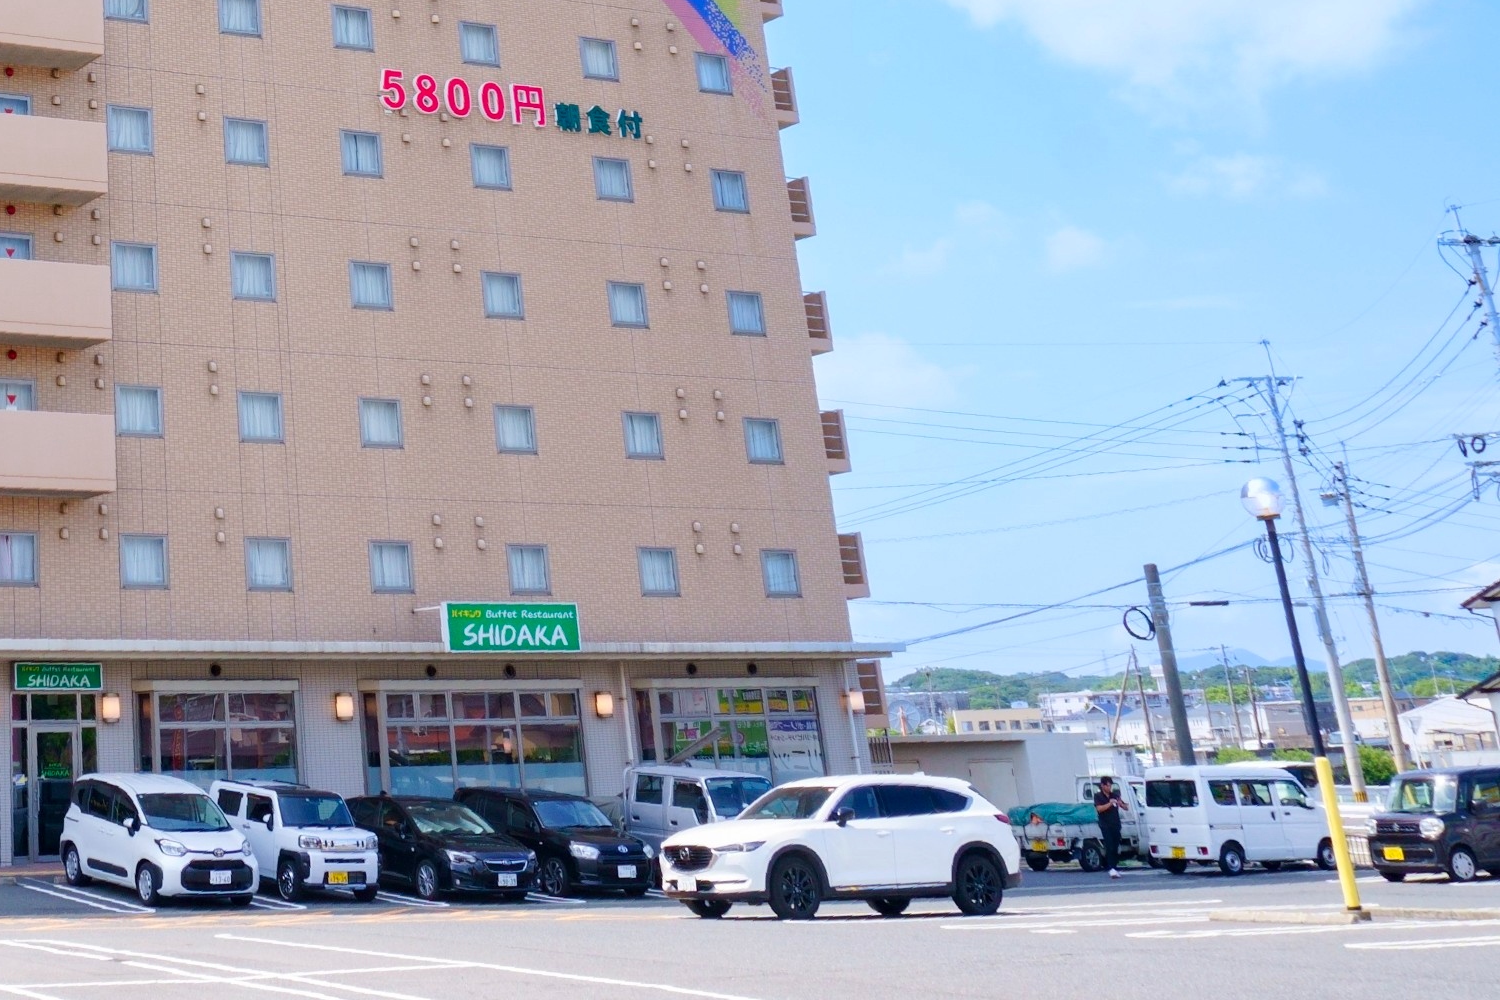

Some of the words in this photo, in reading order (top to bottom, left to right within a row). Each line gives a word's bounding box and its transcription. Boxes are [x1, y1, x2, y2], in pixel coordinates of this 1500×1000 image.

[378, 67, 547, 128] 5800円
[552, 102, 643, 139] 朝食付
[451, 608, 482, 618] バイキング
[485, 609, 518, 619] Buffet
[521, 609, 574, 619] Restaurant
[462, 623, 569, 646] SHIDAKA
[27, 674, 91, 687] SHIDAKA
[41, 769, 70, 777] SHIDAKA
